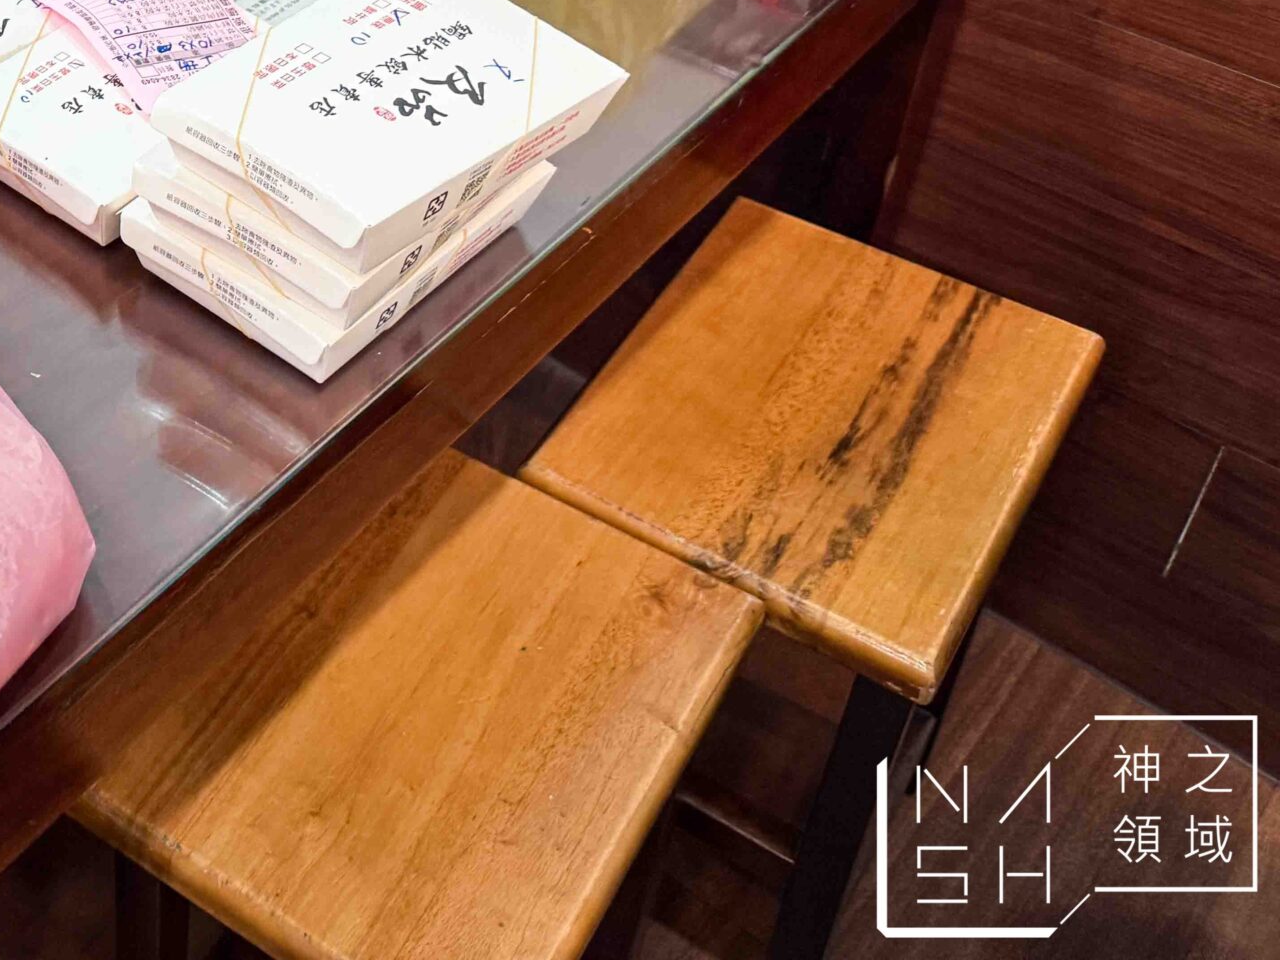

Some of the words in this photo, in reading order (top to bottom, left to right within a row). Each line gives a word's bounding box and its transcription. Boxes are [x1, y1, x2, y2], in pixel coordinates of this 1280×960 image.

[309, 21, 472, 116] 鍋貼水餃專賣店
[392, 64, 488, 127] 及品
